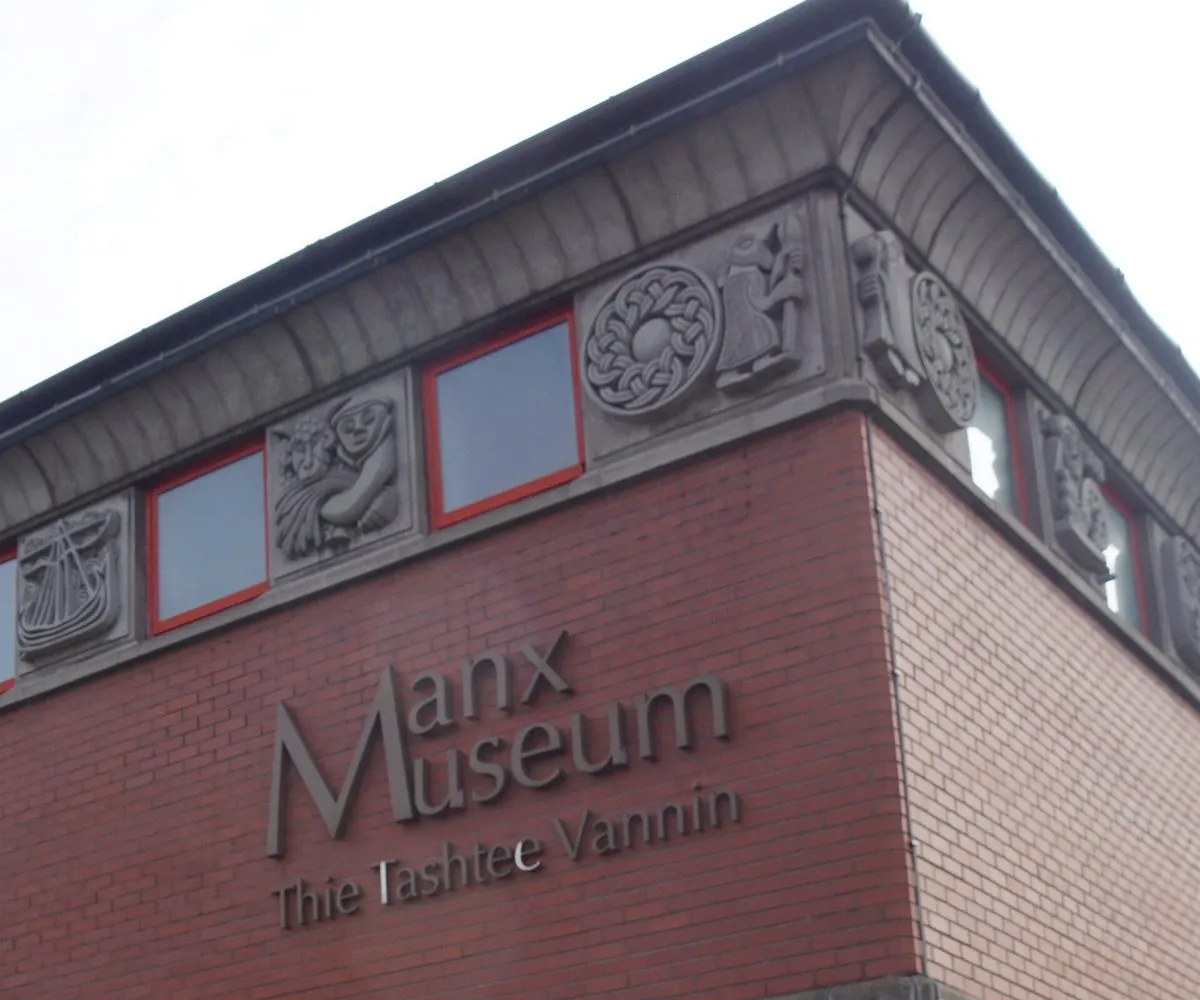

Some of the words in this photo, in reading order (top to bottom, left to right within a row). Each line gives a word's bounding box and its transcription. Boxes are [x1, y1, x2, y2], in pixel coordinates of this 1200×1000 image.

[273, 877, 362, 929] Thie
[371, 837, 542, 905] Tashtee
[552, 782, 742, 862] Vannin
